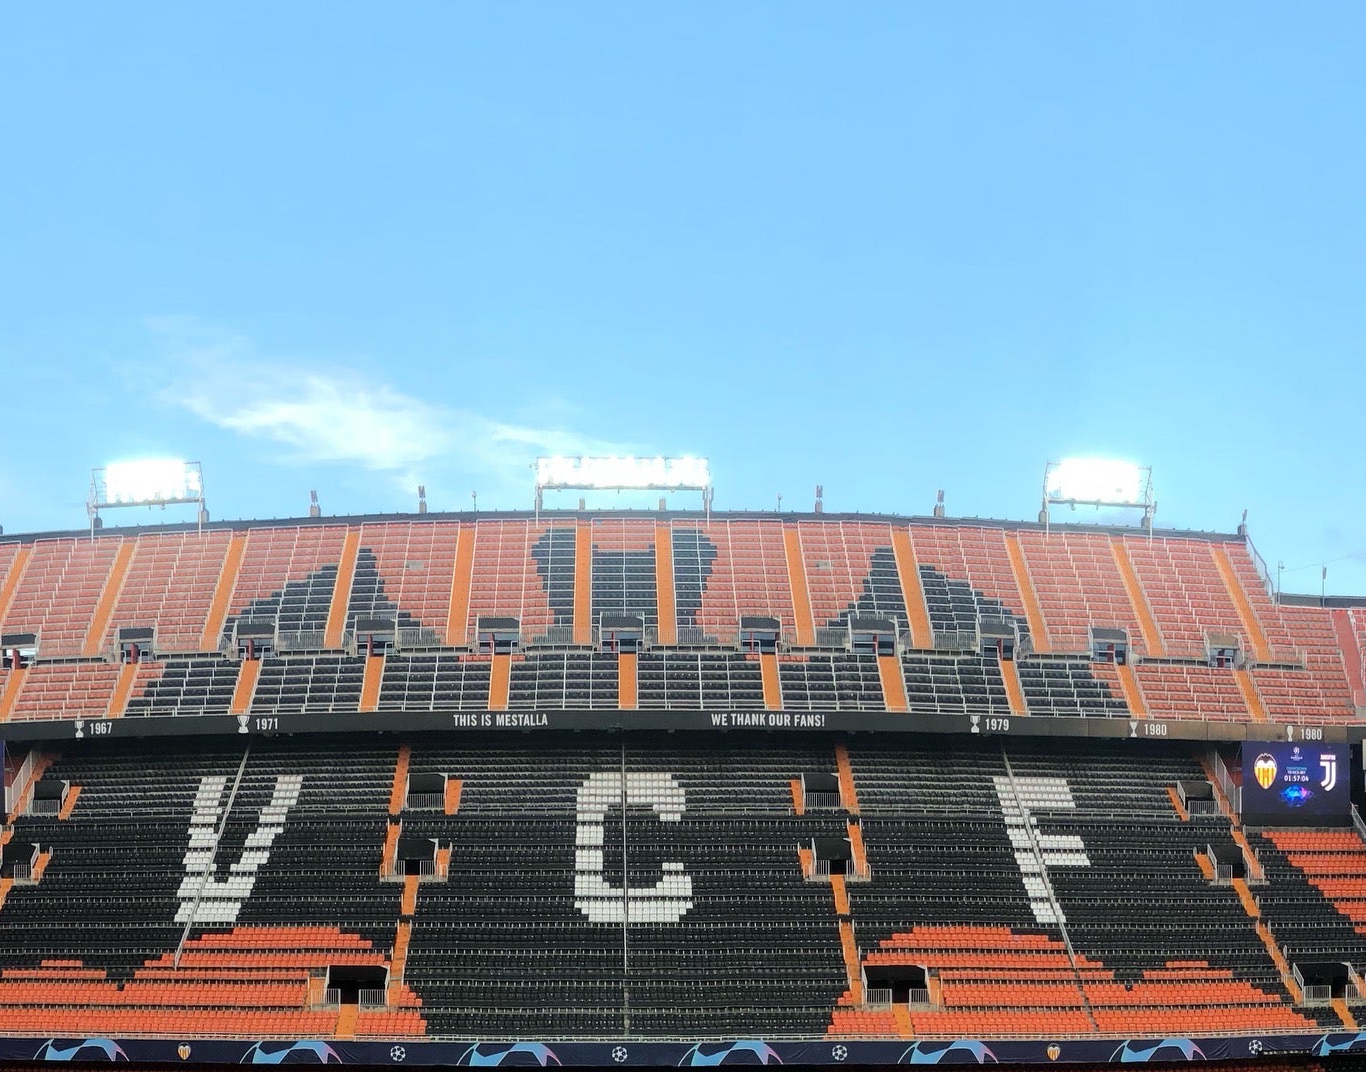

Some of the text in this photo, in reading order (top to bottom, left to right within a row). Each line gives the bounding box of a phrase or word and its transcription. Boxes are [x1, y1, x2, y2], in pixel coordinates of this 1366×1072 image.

[255, 718, 279, 731] 1971
[453, 713, 548, 727] THIS IS MESTALLA
[711, 713, 826, 727] WE THANK OUR FANS!
[985, 718, 1010, 731] 1979
[89, 722, 113, 735] 1967
[1143, 724, 1167, 736] 1980
[1300, 728, 1323, 741] 1980
[573, 771, 694, 924] C
